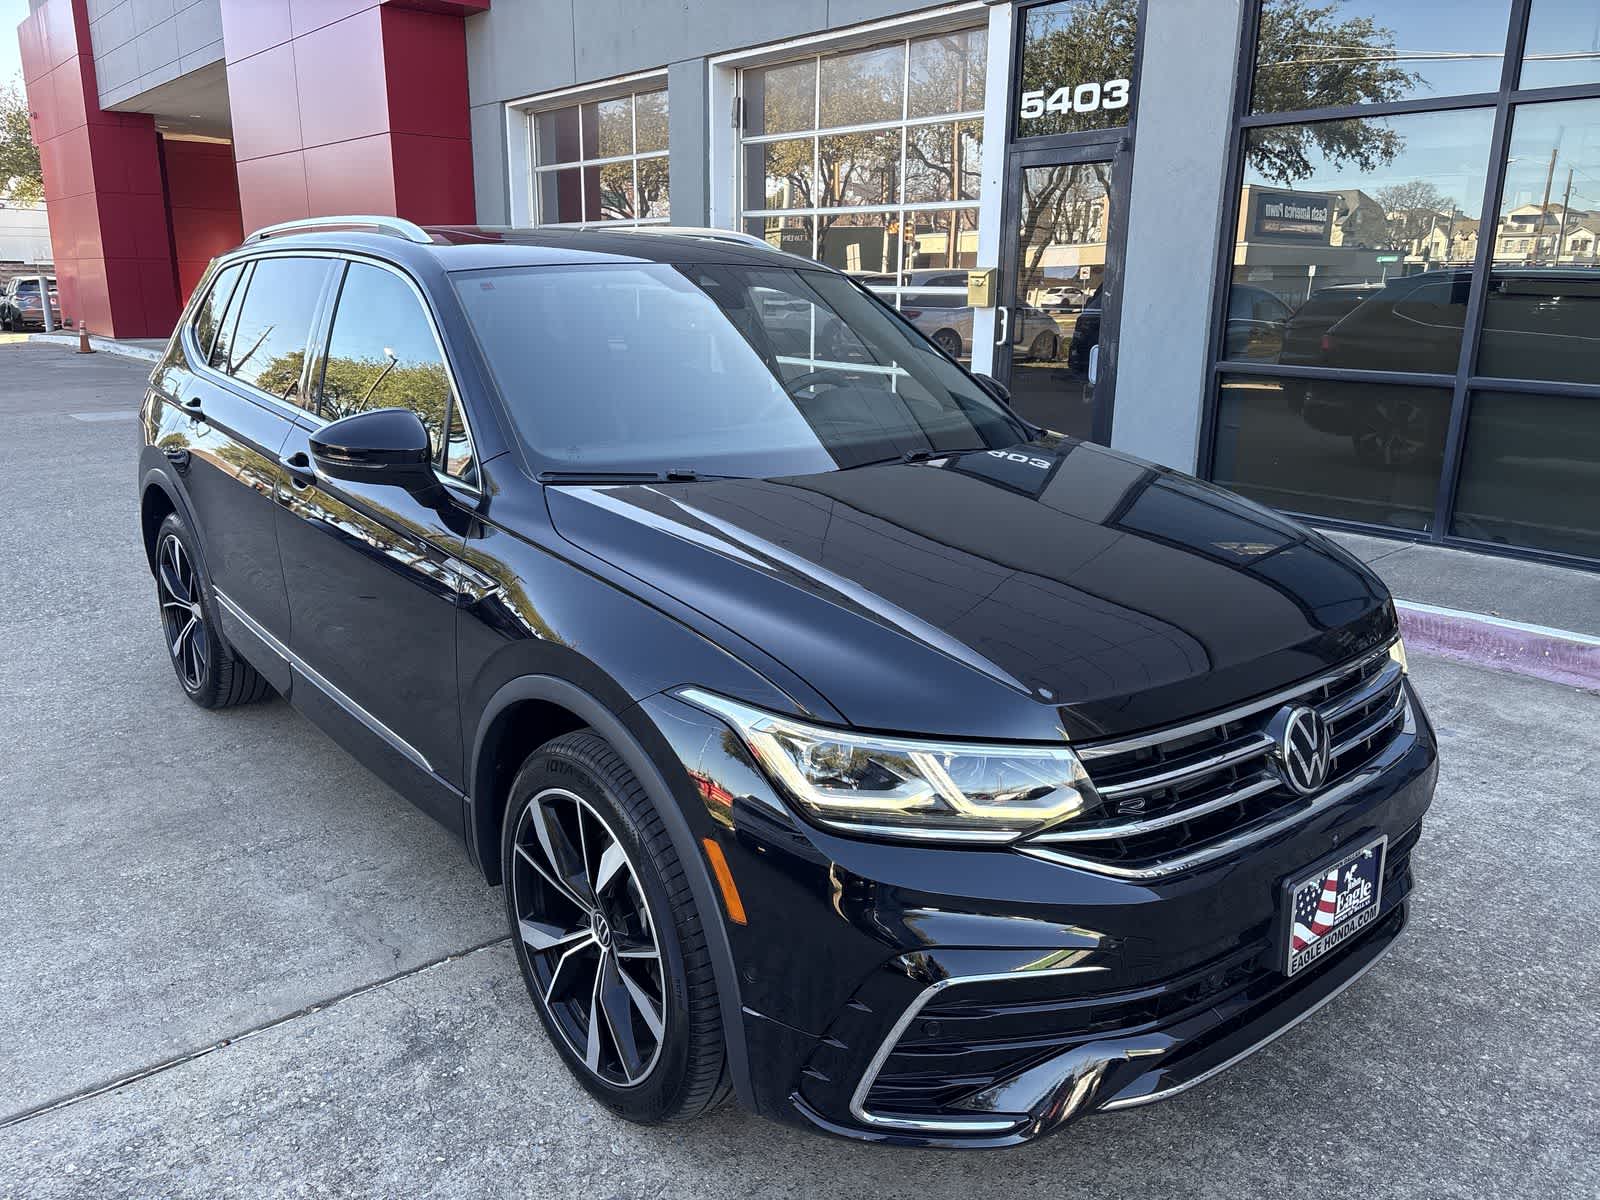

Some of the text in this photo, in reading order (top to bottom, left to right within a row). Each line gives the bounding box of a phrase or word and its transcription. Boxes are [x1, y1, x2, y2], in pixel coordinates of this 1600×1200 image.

[1021, 79, 1130, 119] 5403
[1336, 879, 1371, 915] Eagle
[1291, 905, 1377, 973] EAGLE HONDA.COM
